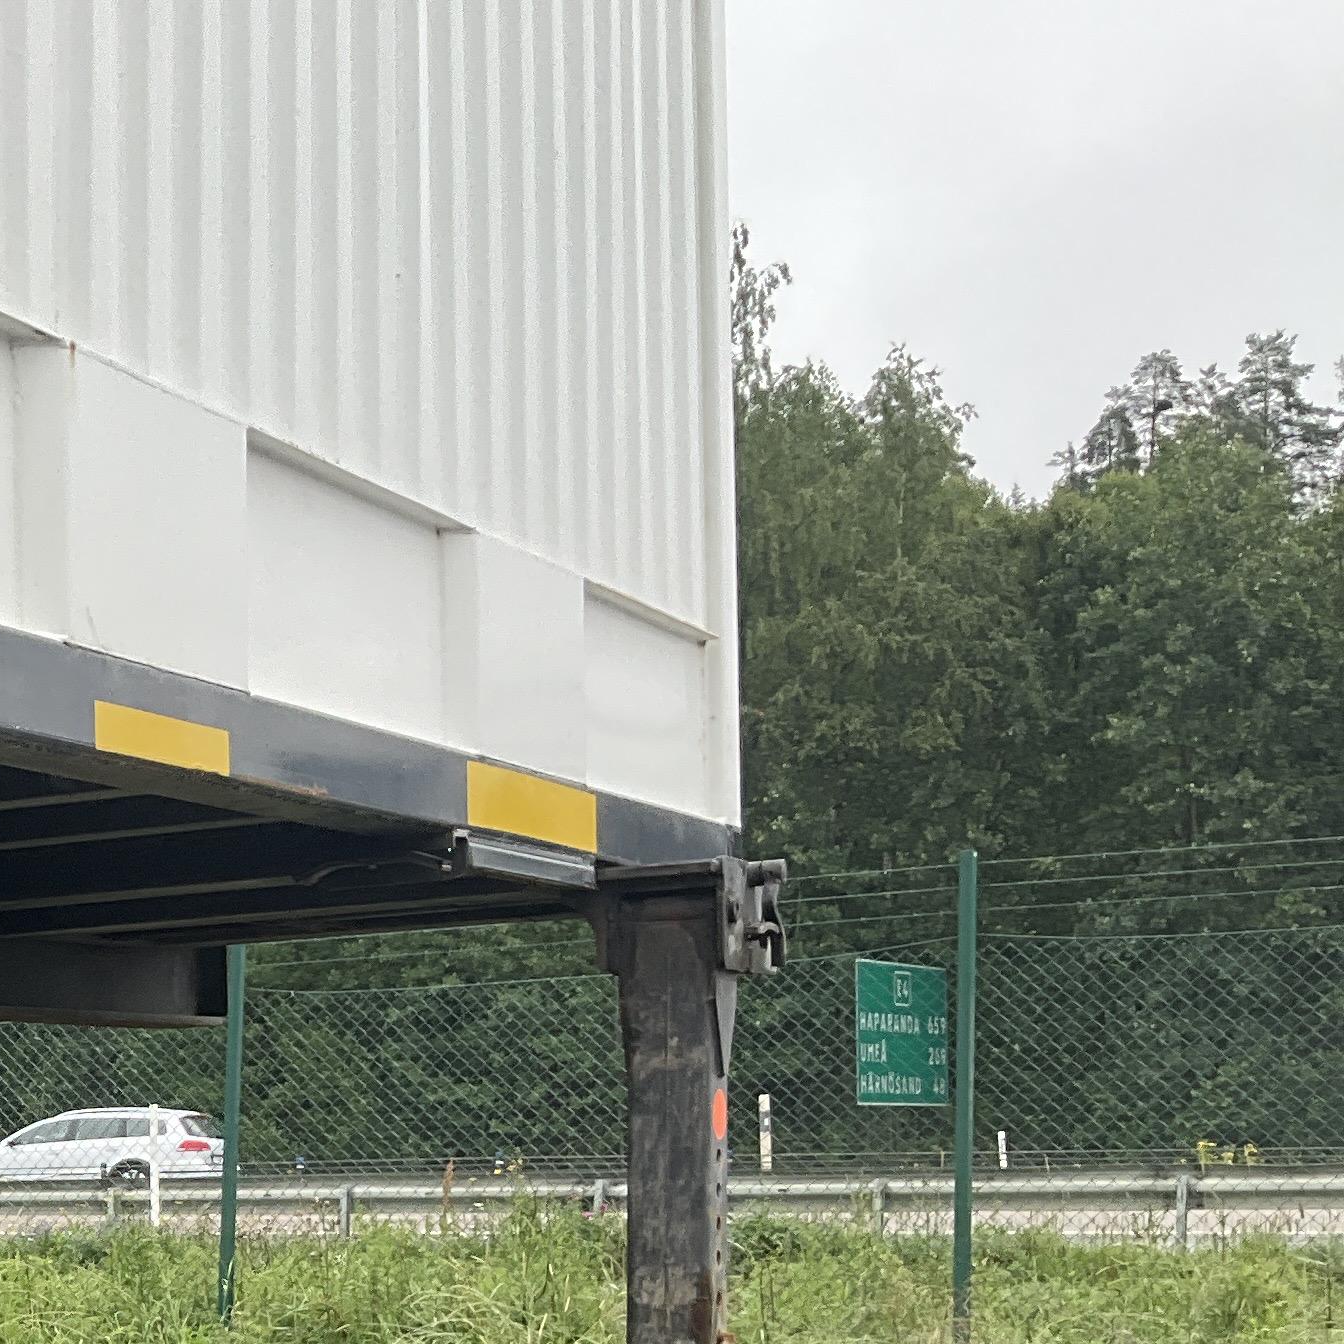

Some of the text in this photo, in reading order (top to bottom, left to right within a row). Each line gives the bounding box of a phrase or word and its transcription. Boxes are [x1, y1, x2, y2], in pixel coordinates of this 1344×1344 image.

[859, 1012, 921, 1035] HAPARANDA
[860, 1039, 888, 1064] UMEÅ
[860, 1071, 922, 1095] HÄRNÖSAND
